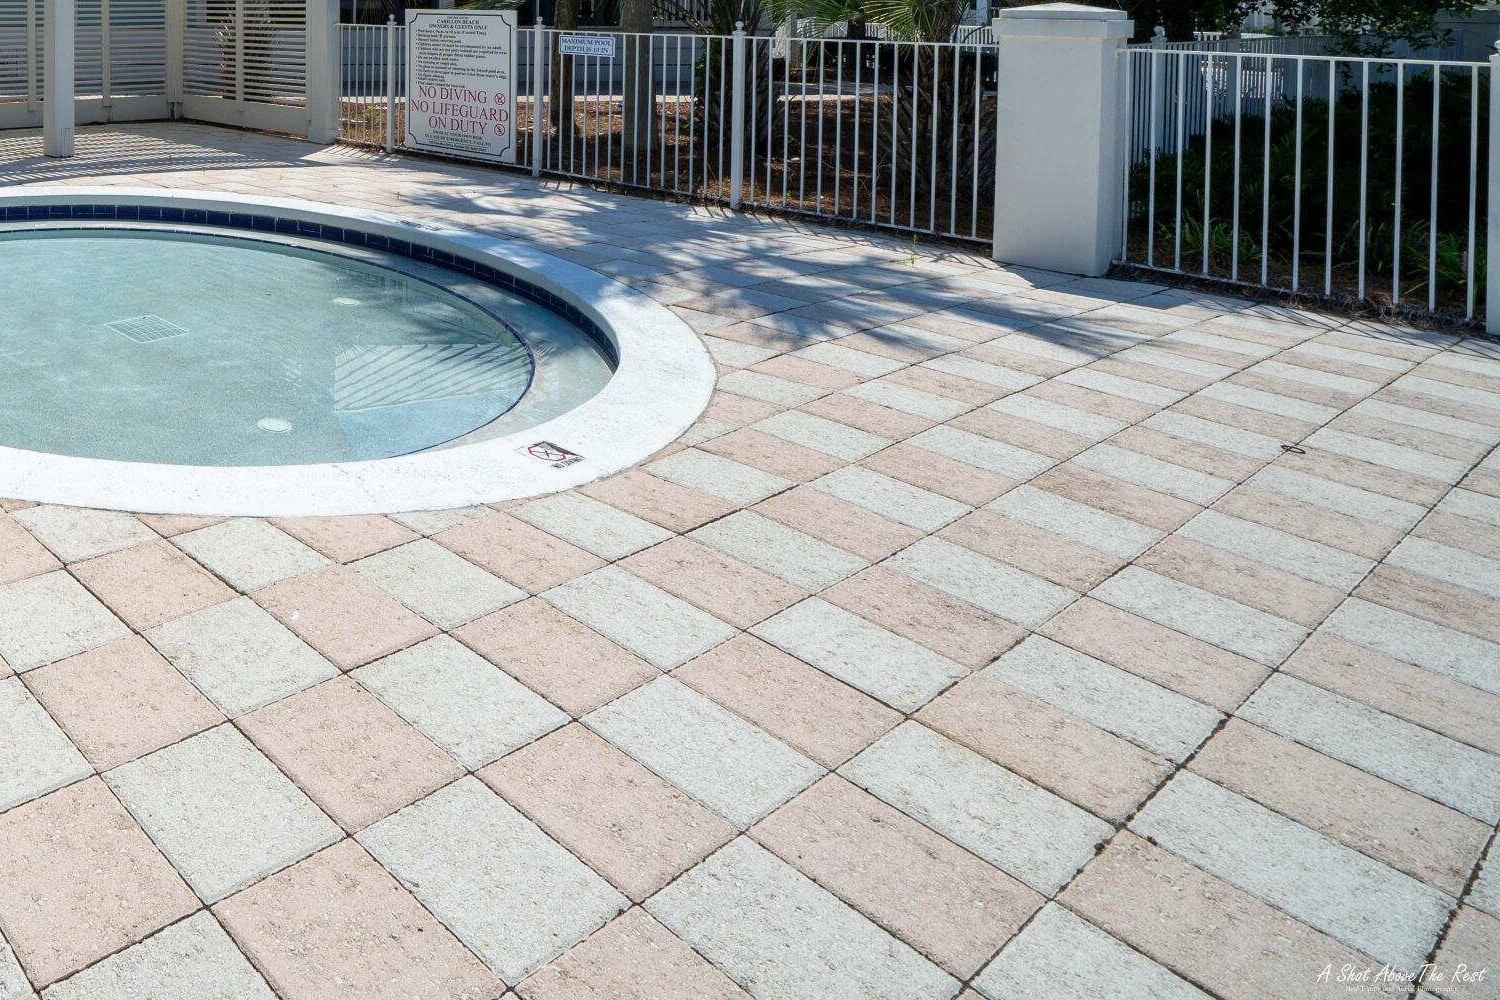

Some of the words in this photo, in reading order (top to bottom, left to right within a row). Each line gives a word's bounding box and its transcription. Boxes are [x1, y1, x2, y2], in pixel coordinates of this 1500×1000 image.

[419, 86, 436, 98] NO
[440, 87, 487, 104] DIVING
[411, 100, 428, 112] NO
[432, 102, 508, 122] LIFEGUARD
[429, 116, 446, 128] ON
[451, 118, 487, 134] DUTY
